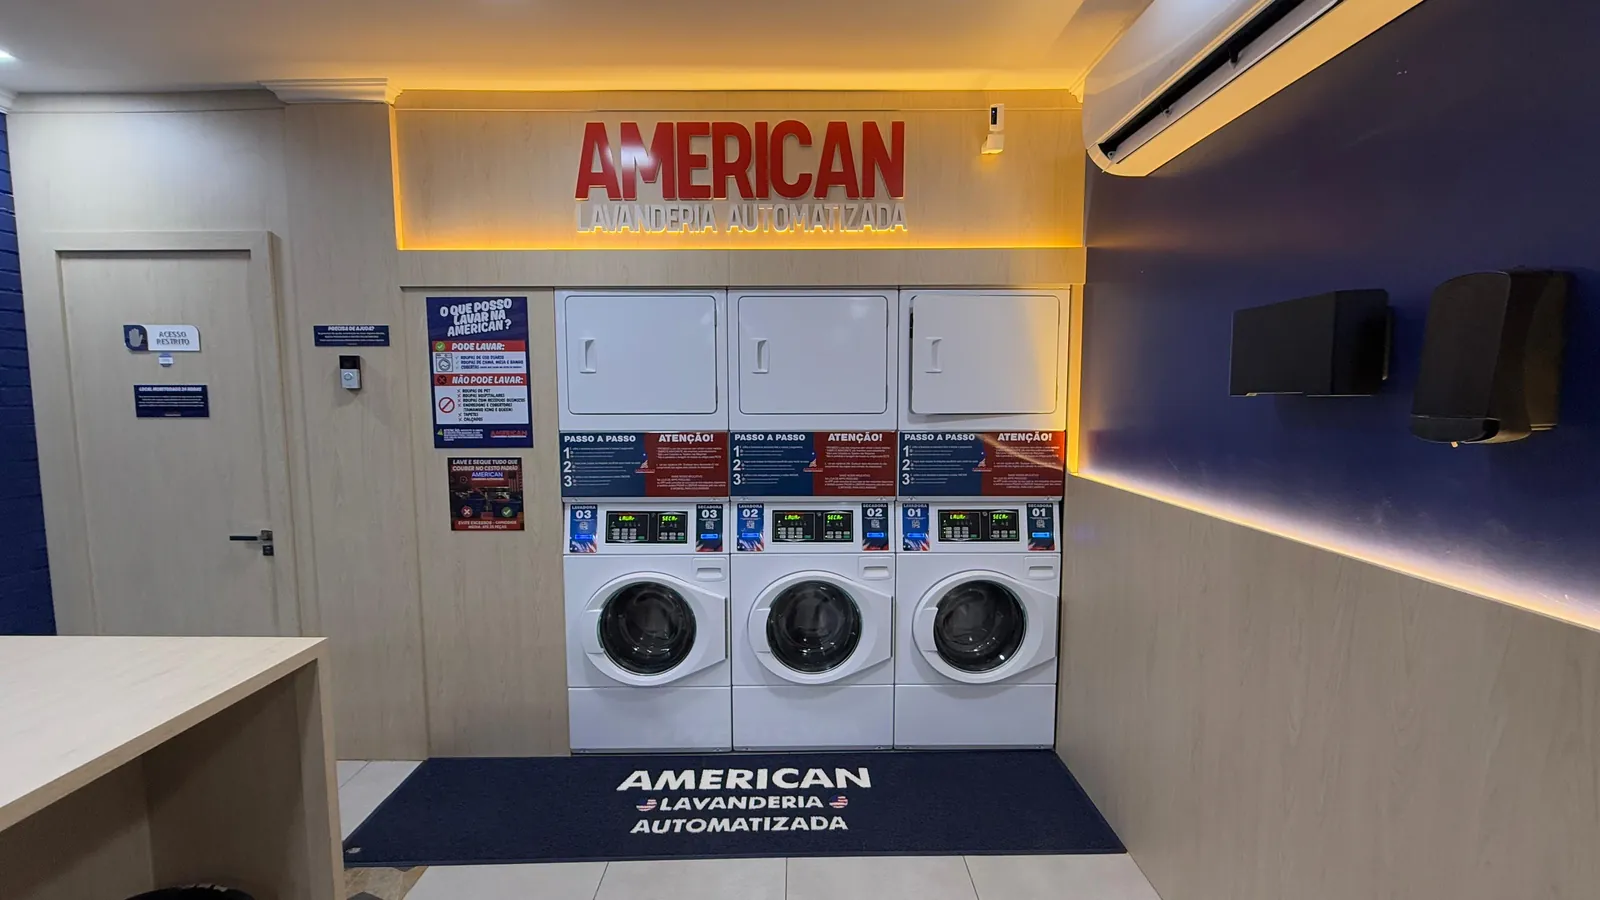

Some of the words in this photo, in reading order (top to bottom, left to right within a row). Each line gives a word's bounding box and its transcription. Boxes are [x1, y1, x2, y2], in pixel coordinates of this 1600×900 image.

[575, 120, 905, 200] AMERICAN
[576, 203, 717, 232] LAVANDERIA
[726, 202, 907, 232] AUTOMATIZADA
[440, 306, 448, 317] O
[450, 302, 473, 315] QUE
[474, 298, 512, 312] POSSO
[453, 312, 489, 325] LAVAR
[490, 309, 506, 321] NA
[156, 338, 190, 346] RESTRITO
[452, 374, 469, 384] NÃO
[470, 376, 493, 384] PODE
[494, 376, 524, 384] LAVAR:
[564, 435, 594, 443] PASSO
[597, 435, 603, 443] A
[606, 435, 636, 443] PASSO
[659, 433, 714, 444] ATENÇÃO!
[828, 432, 882, 443] ATENÇÃO!
[998, 432, 1052, 443] ATENÇÃO!
[563, 447, 570, 459] 1
[733, 445, 740, 457] 1
[902, 445, 909, 457] 1
[563, 461, 572, 473] 2
[732, 459, 741, 471] 2
[902, 459, 910, 471] 2
[564, 475, 572, 487] 3
[733, 473, 741, 485] 3
[902, 473, 910, 485] 3
[575, 510, 591, 519] 03
[701, 509, 718, 518] 03
[742, 508, 759, 517] 02
[866, 508, 883, 517] 02
[907, 508, 921, 517] 01
[1032, 508, 1046, 517] 01
[616, 767, 872, 791] AMERICAN
[659, 795, 824, 812] LAVANDERIA
[629, 816, 848, 834] AUTOMATIZADA
